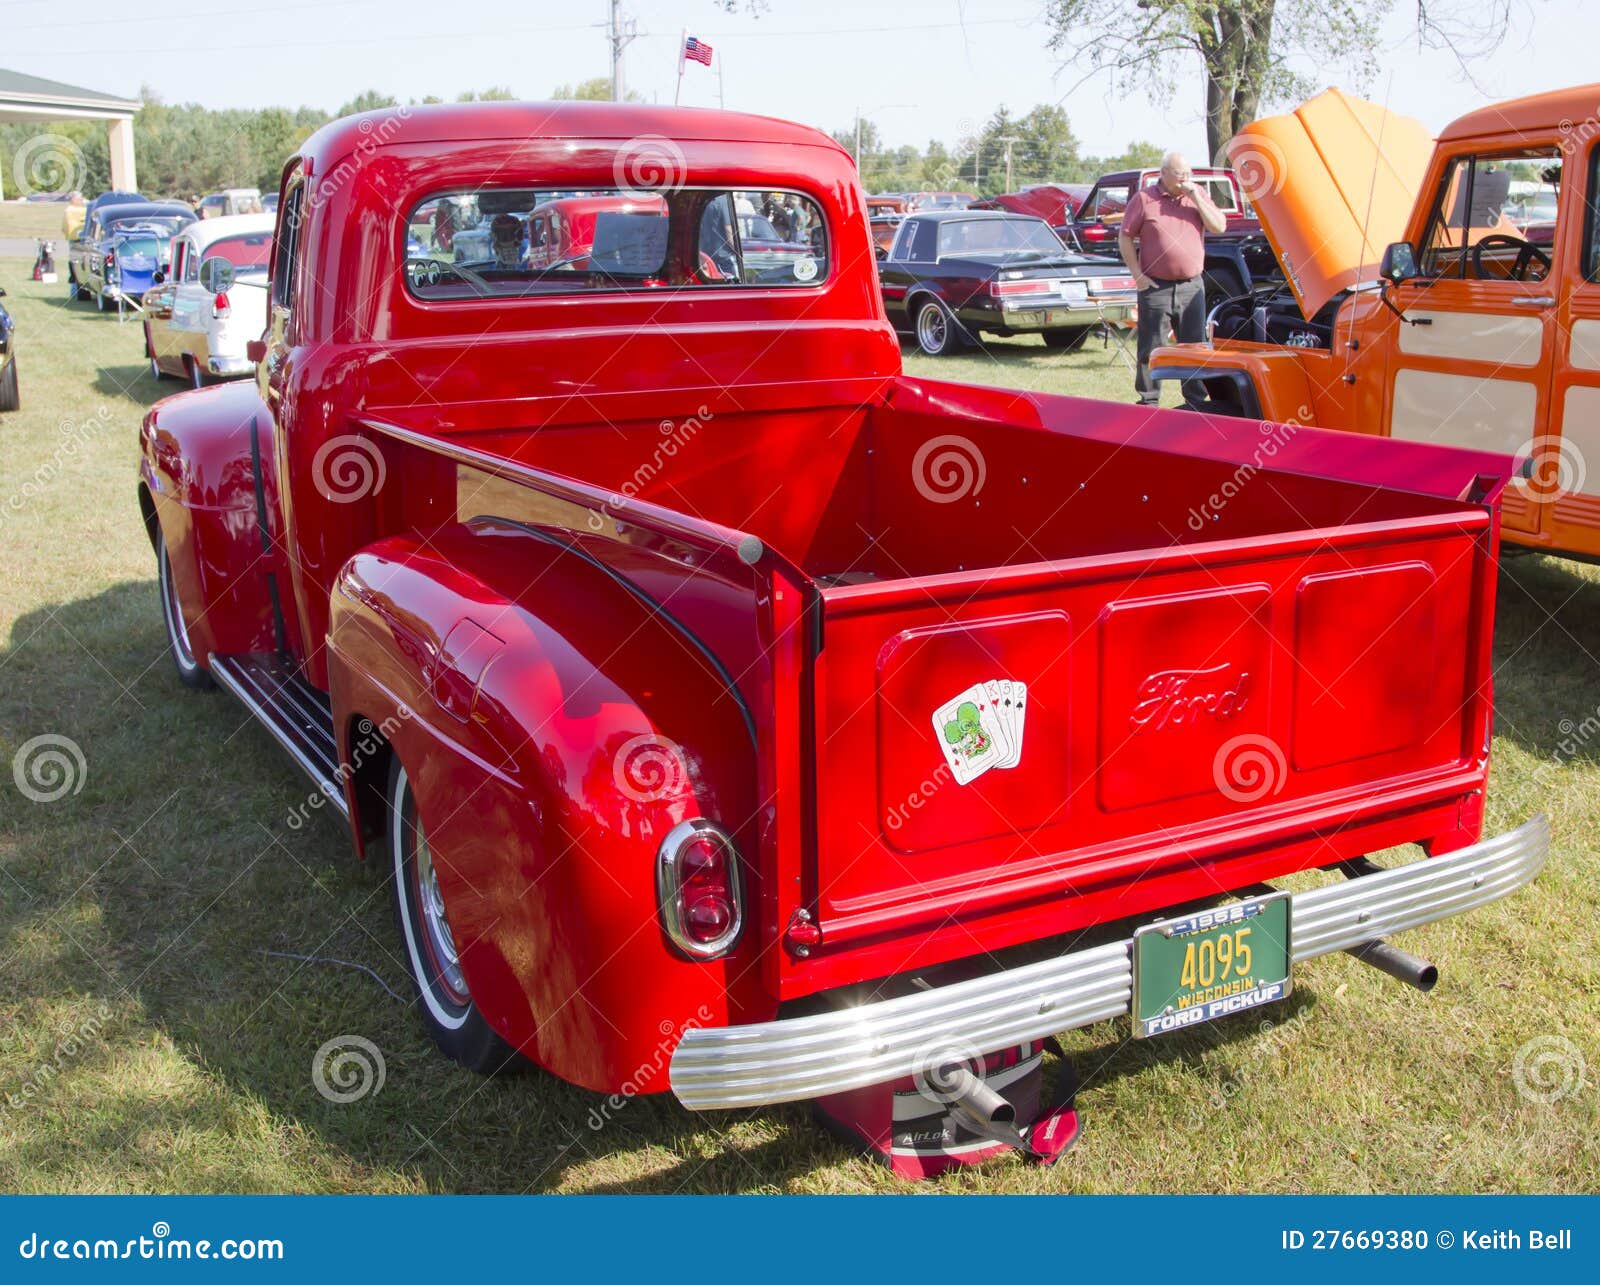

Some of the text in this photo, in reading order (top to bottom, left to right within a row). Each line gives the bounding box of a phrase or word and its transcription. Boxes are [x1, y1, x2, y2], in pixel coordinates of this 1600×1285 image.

[1003, 682, 1011, 695] 5
[1018, 685, 1025, 699] 2
[1128, 662, 1249, 731] Ford
[1180, 928, 1252, 990] 4095
[1148, 985, 1281, 1034] FORD PICKUP
[1177, 976, 1253, 1010] WISCONSIN
[902, 1128, 951, 1144] AirLok
